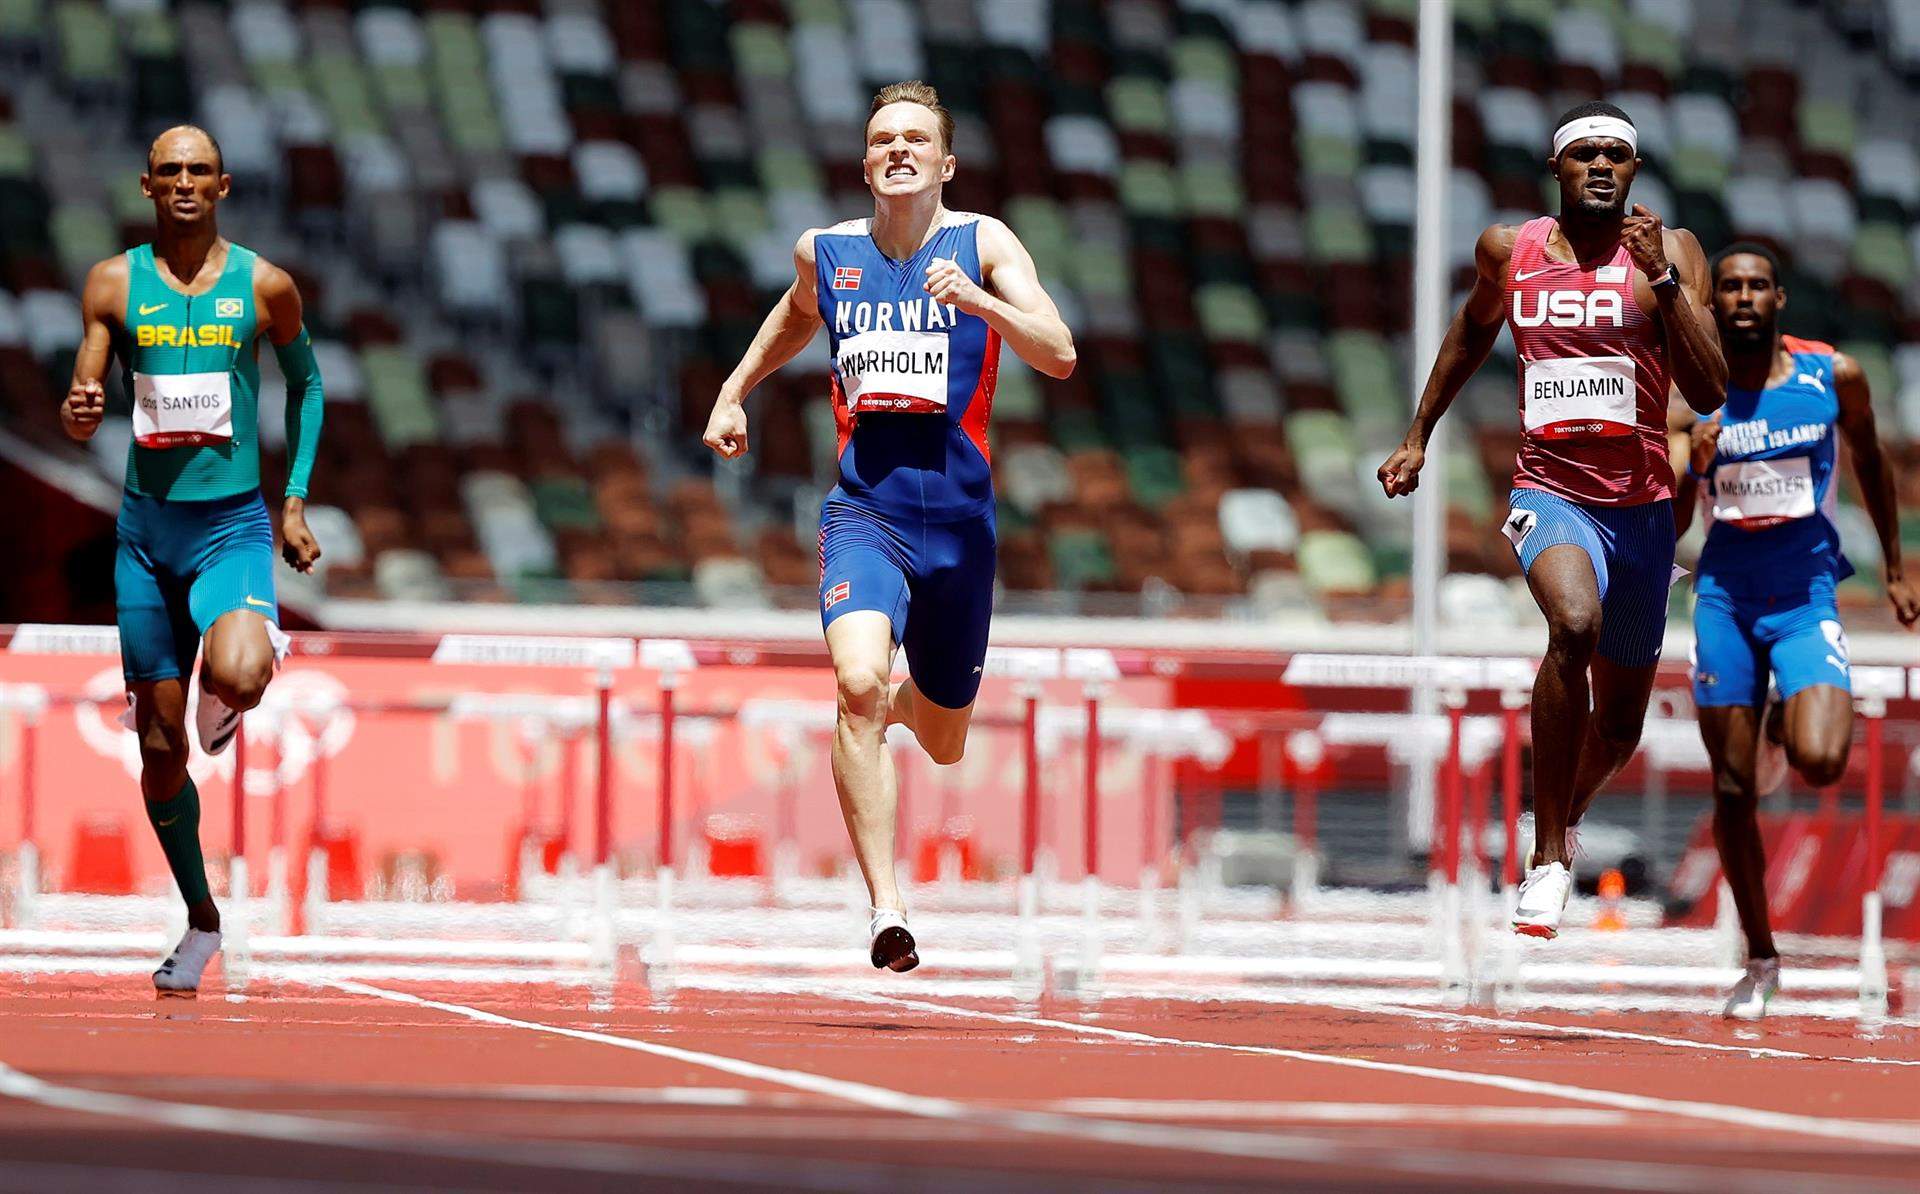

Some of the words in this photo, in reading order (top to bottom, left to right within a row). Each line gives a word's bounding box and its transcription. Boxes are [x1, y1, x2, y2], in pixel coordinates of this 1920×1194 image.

[835, 297, 958, 334] NORWAY
[1512, 290, 1624, 327] USA
[136, 324, 242, 348] BRASIL
[841, 350, 944, 378] WARHOLM
[1534, 377, 1625, 400] BENJAMIN
[162, 394, 220, 410] SANTOS
[1720, 475, 1806, 497] McMASTER
